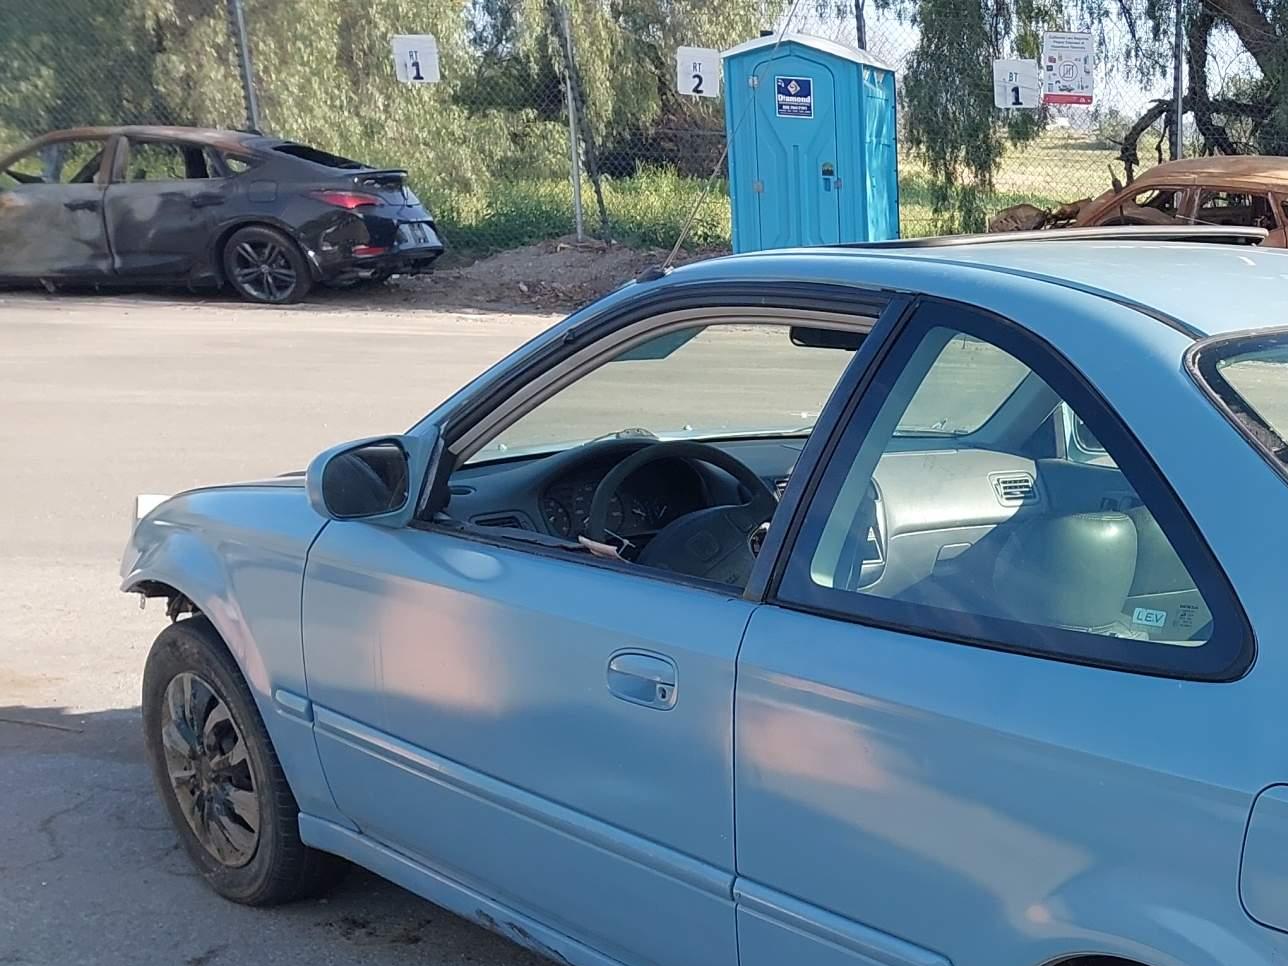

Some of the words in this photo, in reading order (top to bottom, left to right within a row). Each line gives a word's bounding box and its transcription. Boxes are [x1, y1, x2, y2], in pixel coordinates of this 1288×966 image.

[411, 61, 424, 80] 1
[692, 62, 702, 72] RT
[1008, 72, 1019, 82] BT
[692, 74, 704, 94] 2
[777, 94, 811, 103] Diamond
[1011, 86, 1023, 105] 1
[1136, 610, 1164, 623] LEV
